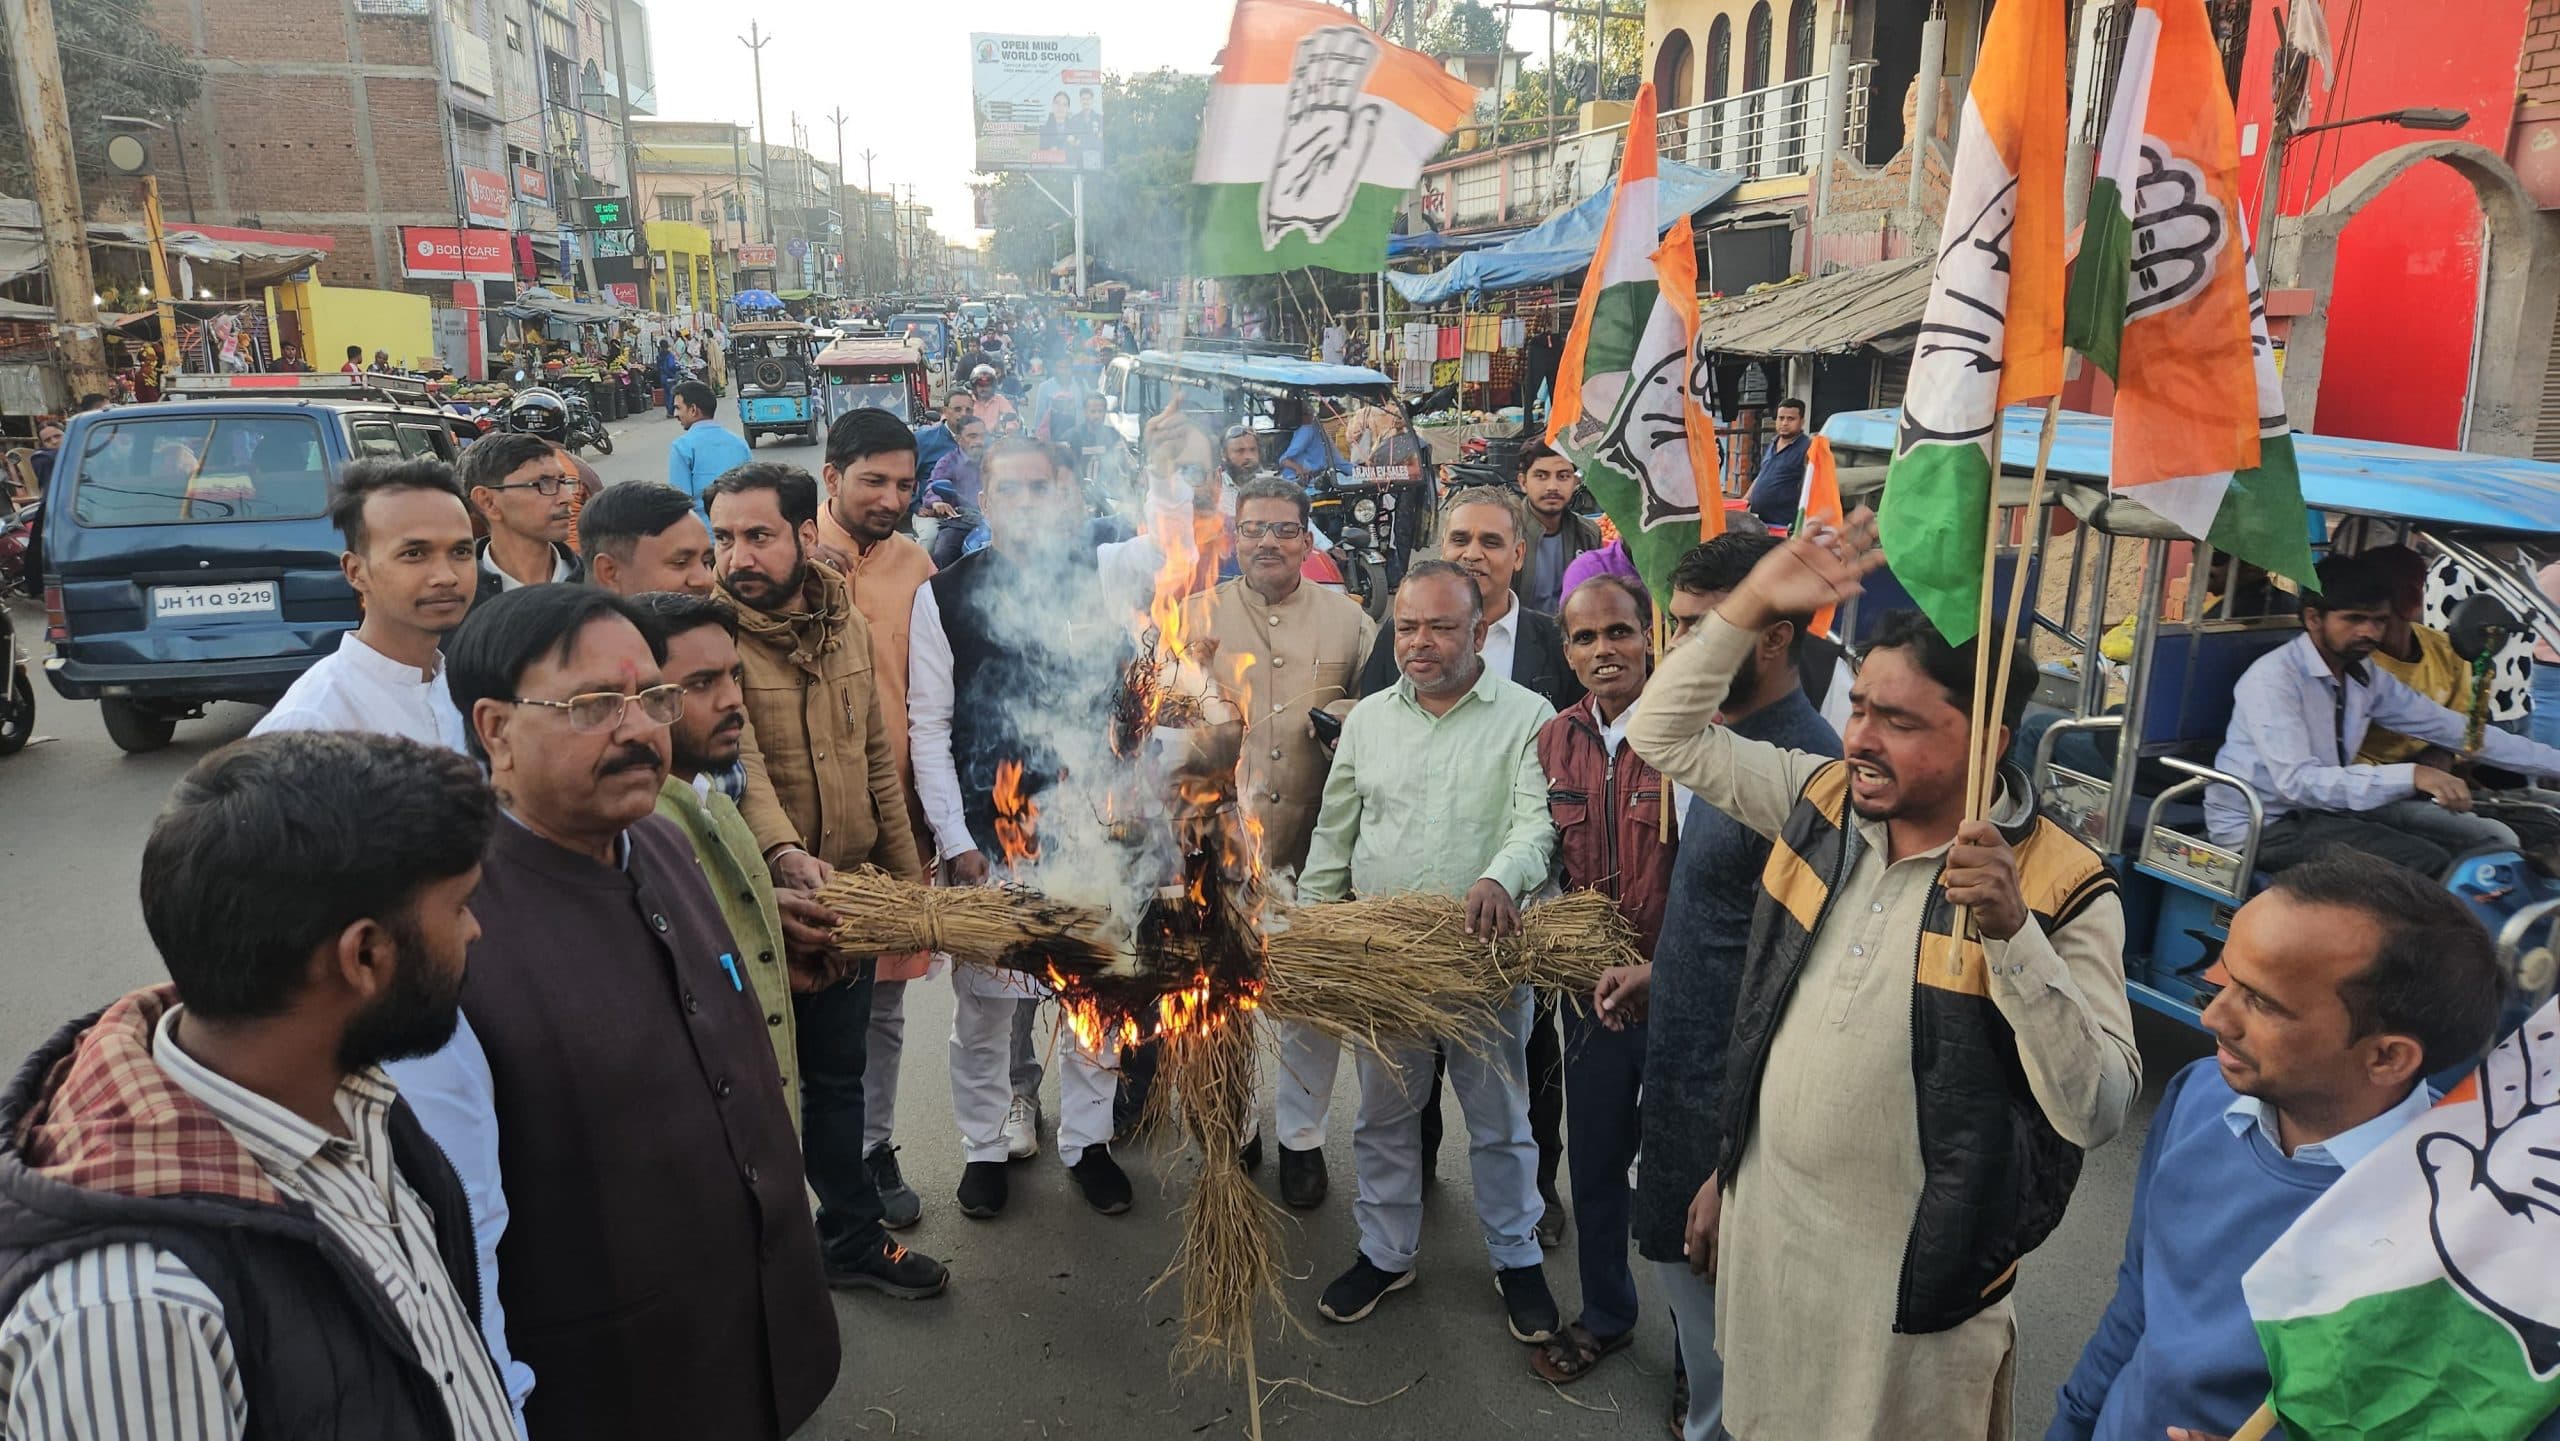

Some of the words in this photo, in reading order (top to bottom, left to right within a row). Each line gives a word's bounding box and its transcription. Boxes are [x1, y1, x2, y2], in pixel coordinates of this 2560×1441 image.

[1001, 40, 1030, 50] OPEN
[1032, 41, 1058, 51] MIND
[1001, 51, 1038, 61] WORLD
[1040, 52, 1082, 62] SCHOOL
[436, 244, 500, 257] BODYCARE
[158, 596, 182, 610] JH
[187, 595, 204, 607] 11
[209, 594, 223, 606] Q
[227, 590, 271, 605] 9219
